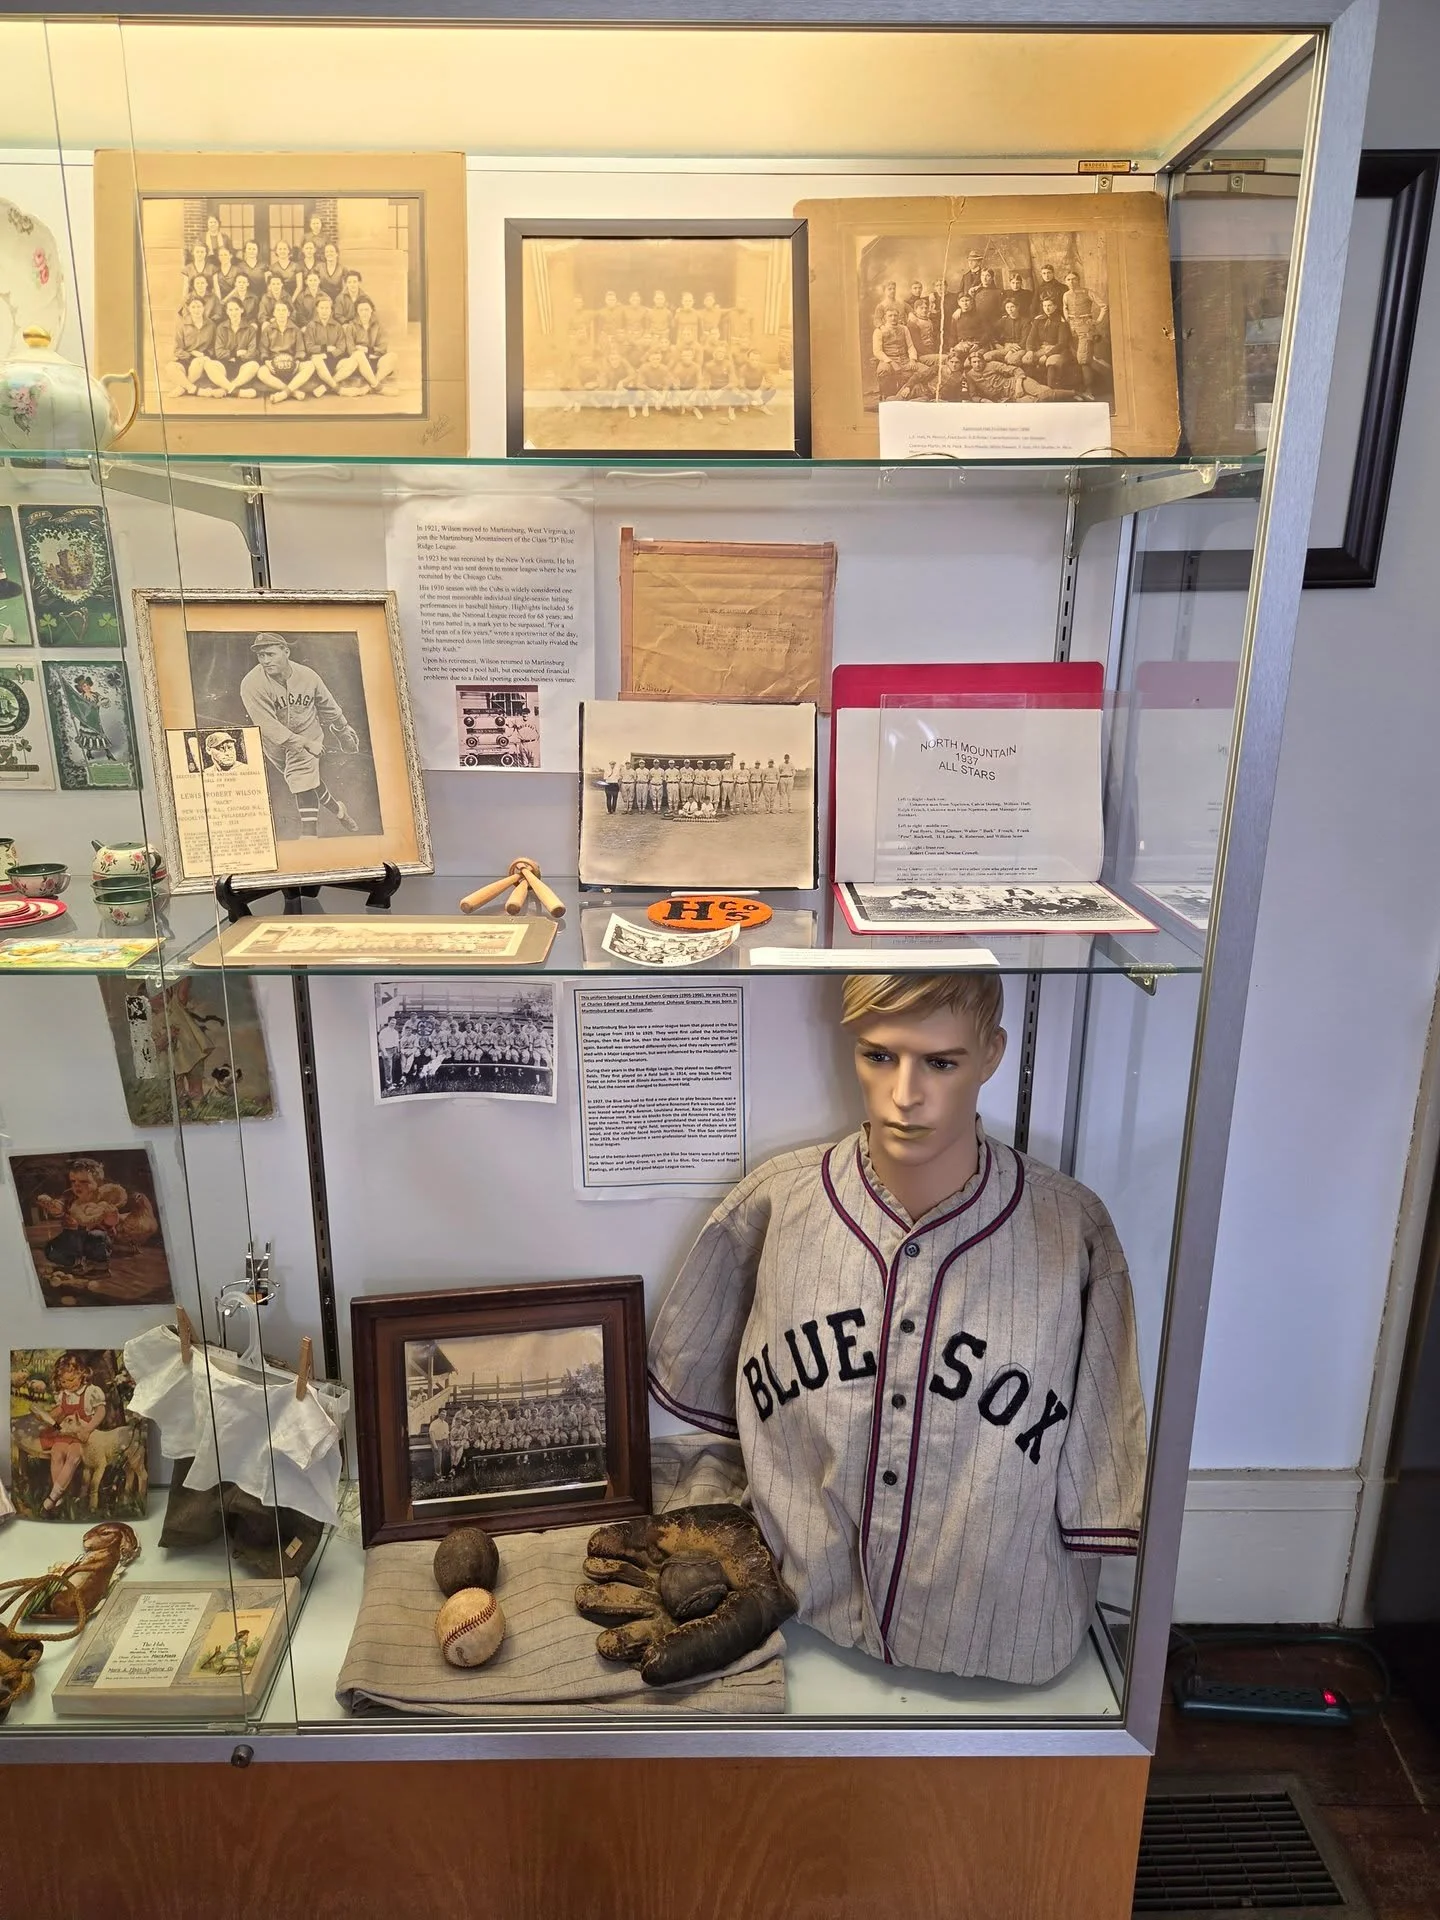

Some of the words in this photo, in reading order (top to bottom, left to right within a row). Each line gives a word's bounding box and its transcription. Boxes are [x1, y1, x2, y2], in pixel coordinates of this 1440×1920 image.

[920, 738, 958, 752] NORTH
[960, 742, 1016, 758] MOUNTAIN
[956, 752, 978, 766] 1937
[938, 761, 958, 772] ALL
[960, 764, 996, 780] STARS
[662, 900, 714, 920] H
[743, 1308, 877, 1422] BLUE
[929, 1331, 1068, 1465] SOX
